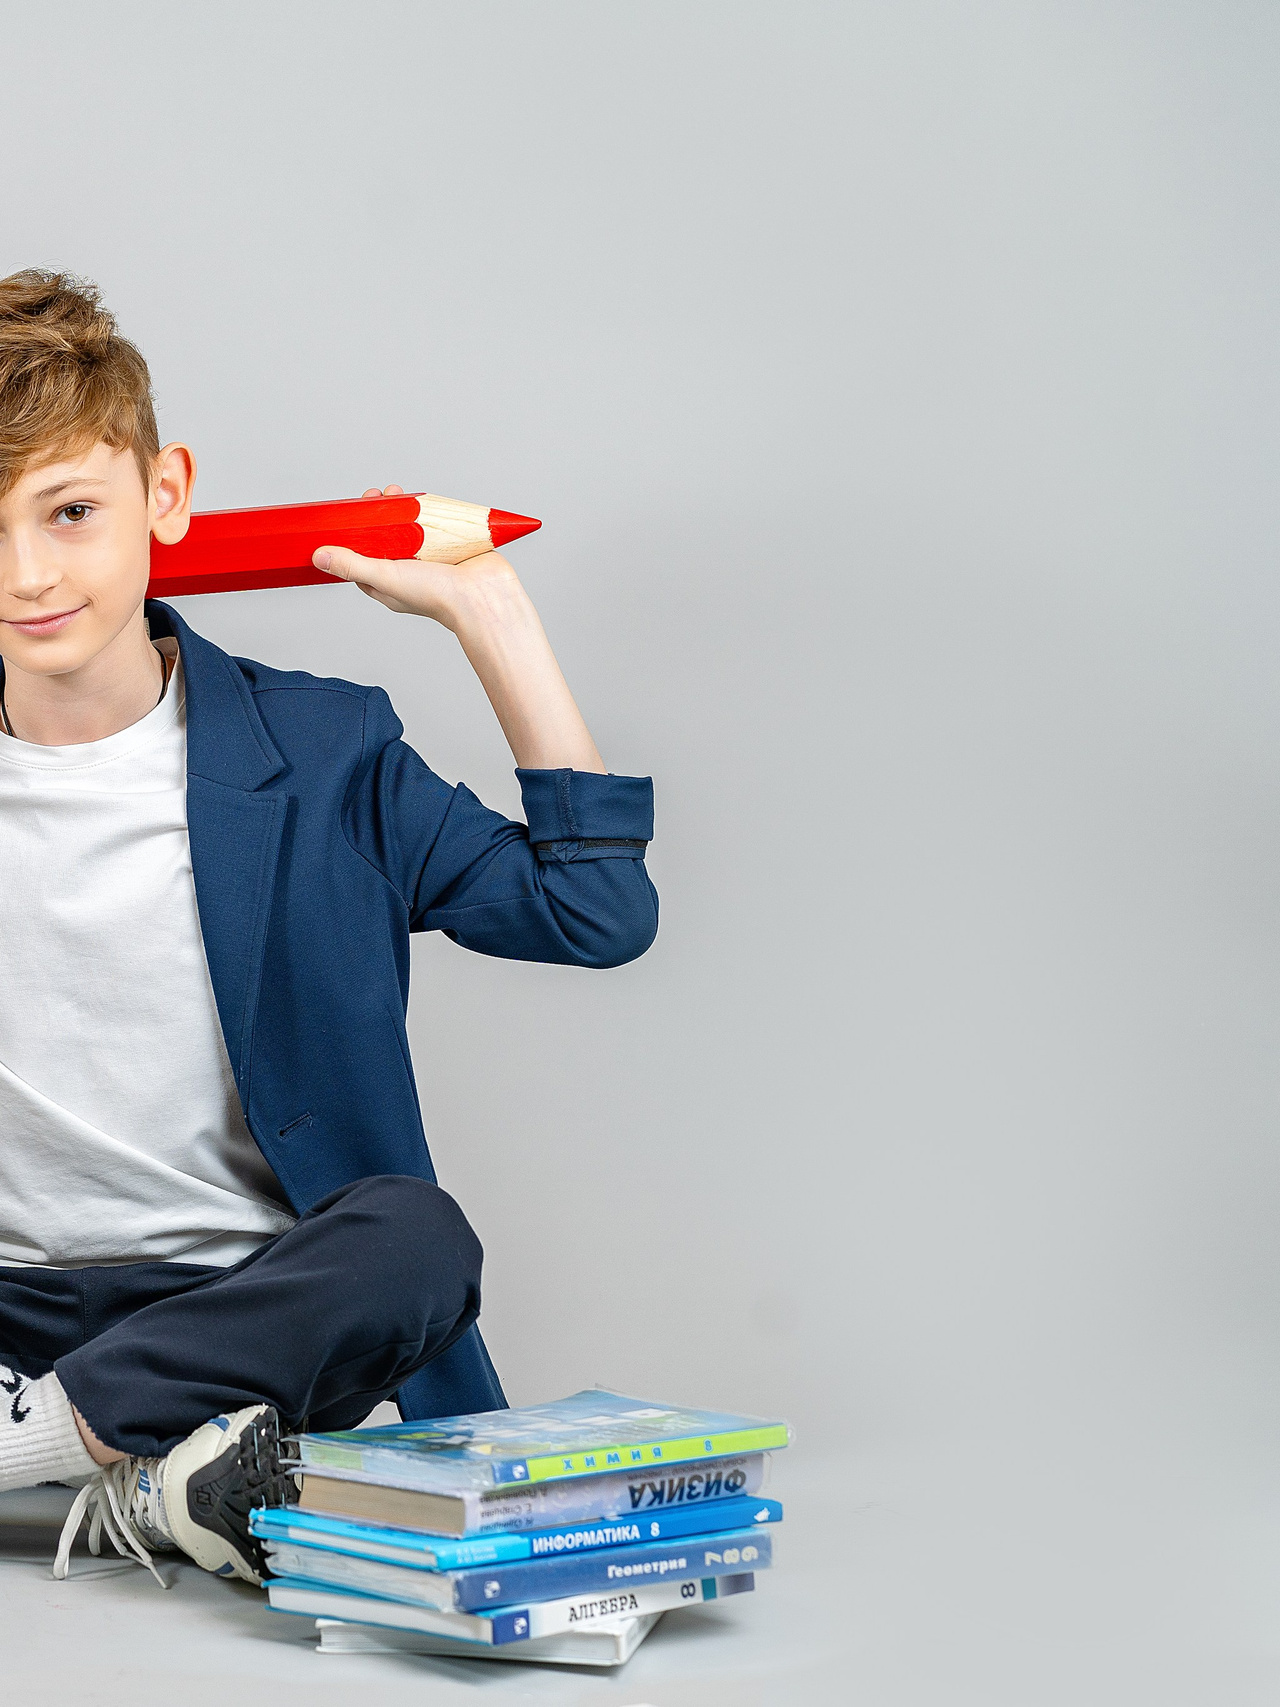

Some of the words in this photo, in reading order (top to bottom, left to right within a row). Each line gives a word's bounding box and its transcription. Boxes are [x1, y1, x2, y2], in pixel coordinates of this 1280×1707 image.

[562, 1446, 663, 1470] ХИМИЯ
[703, 1438, 714, 1452] 8
[628, 1468, 747, 1509] ФИЗИКА
[532, 1524, 641, 1554] ИНФОРМАТИКА
[650, 1522, 661, 1538] 8
[607, 1558, 687, 1579] Геометрия
[569, 1594, 639, 1621] АЛГЕБРА
[681, 1582, 696, 1599] 8
